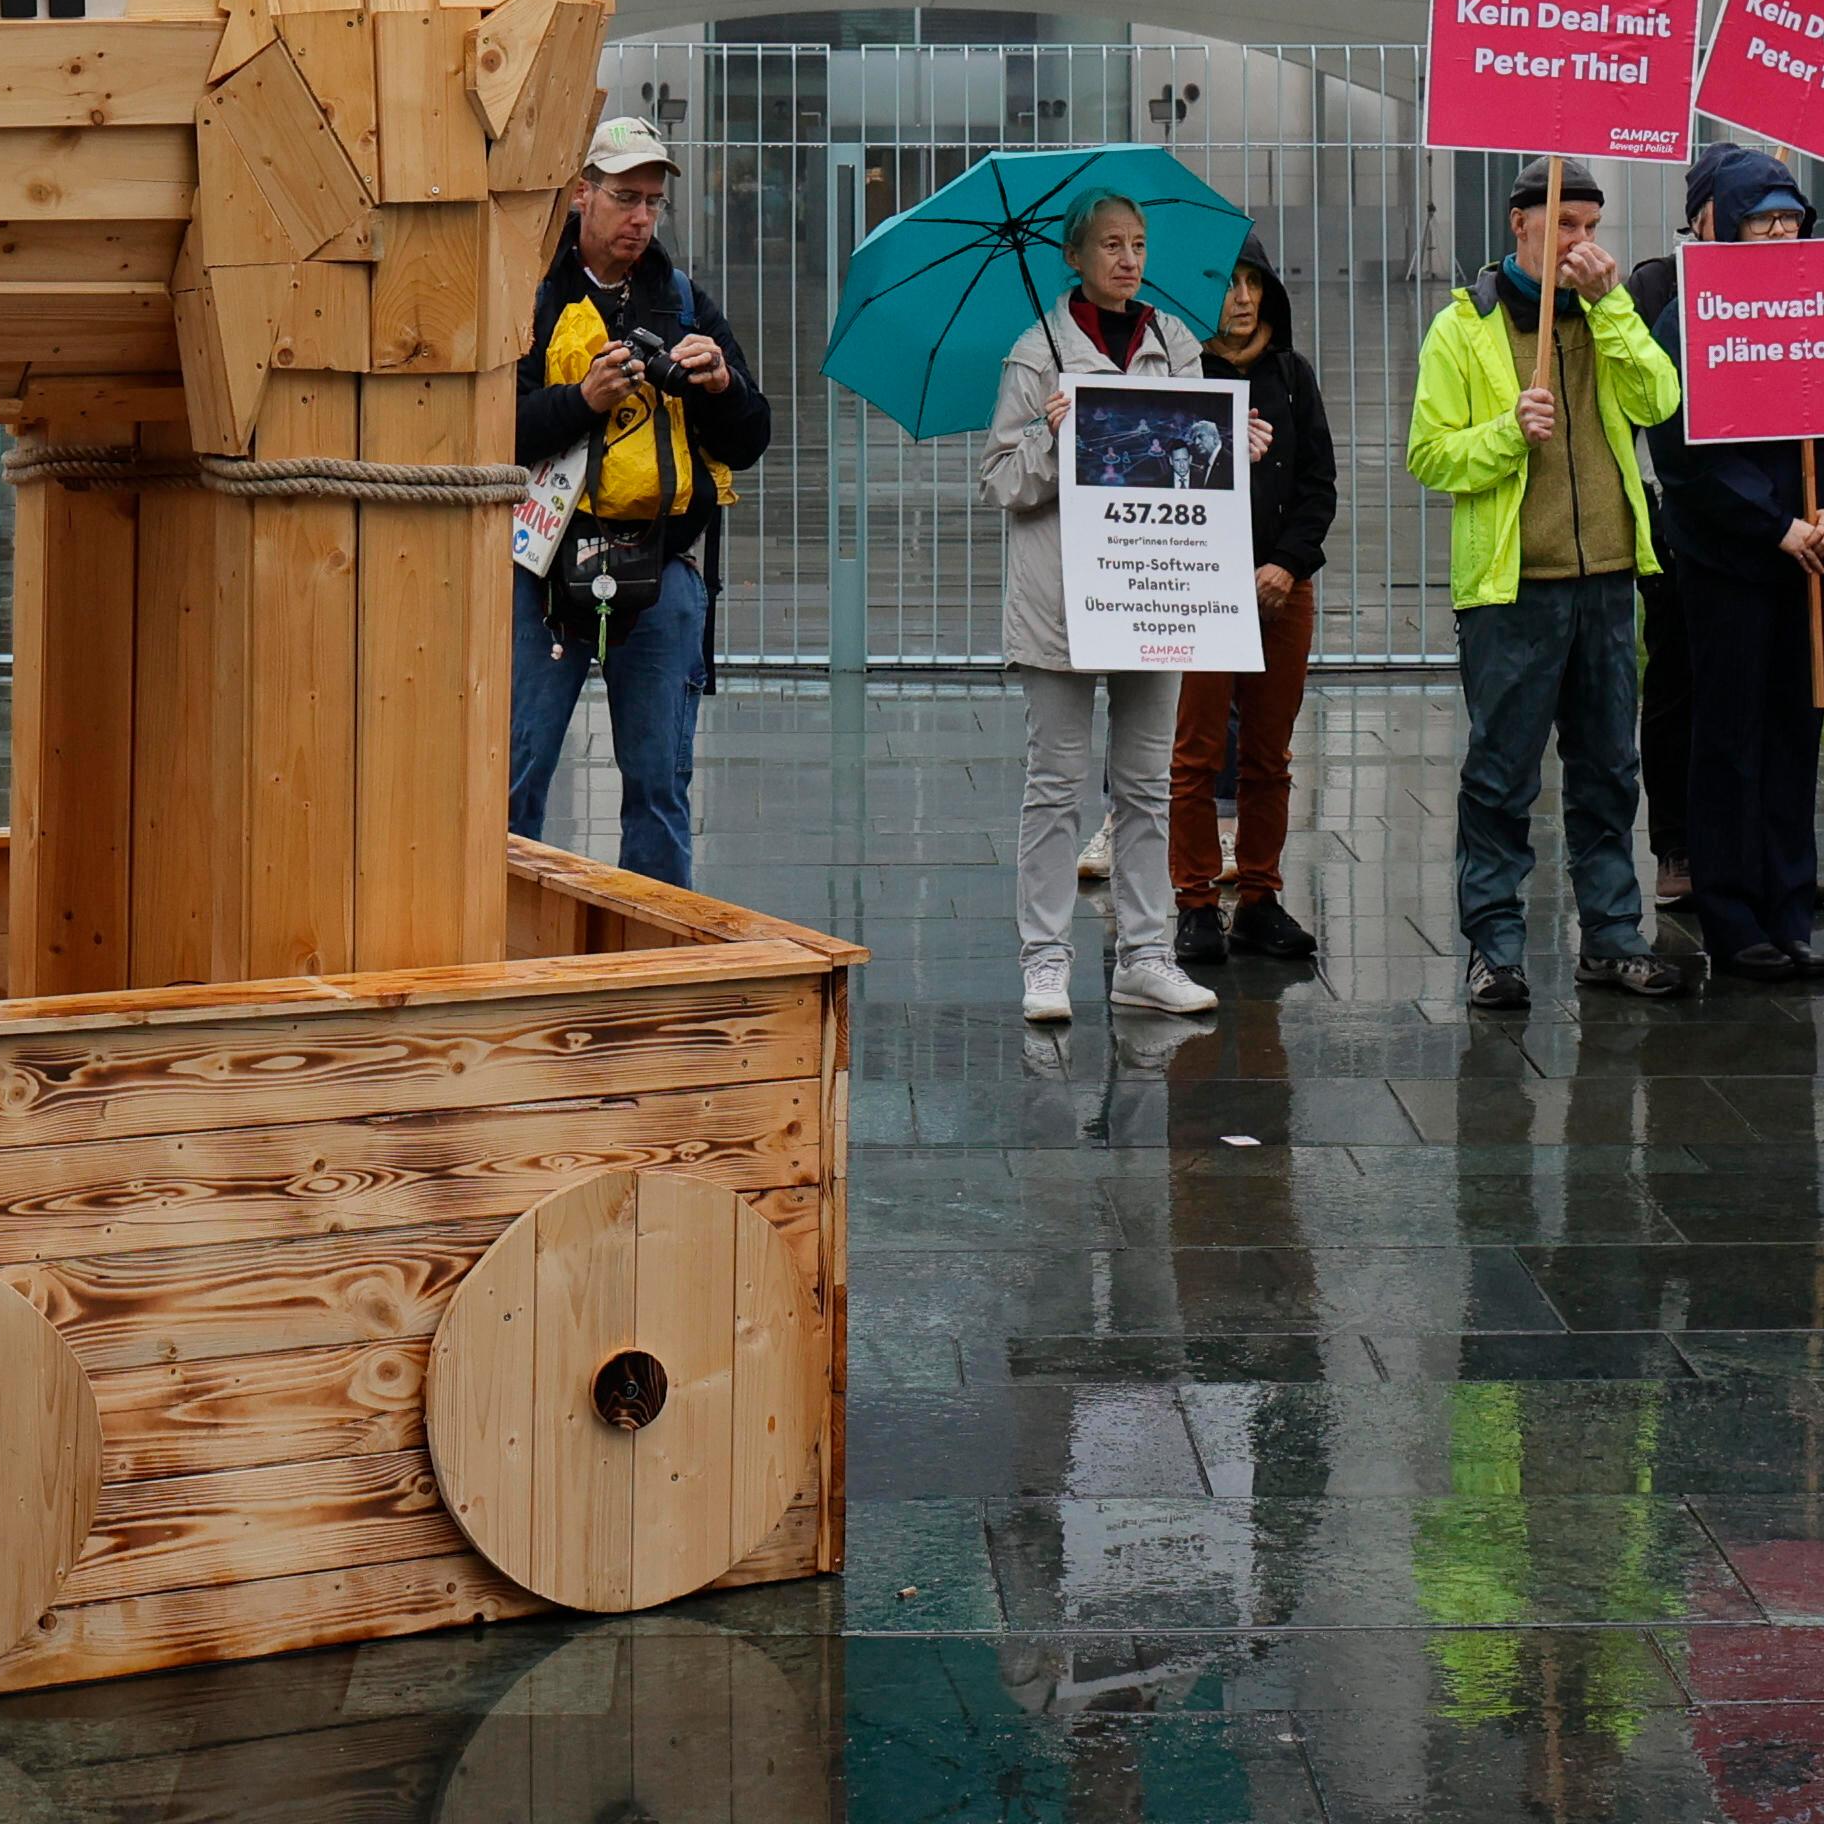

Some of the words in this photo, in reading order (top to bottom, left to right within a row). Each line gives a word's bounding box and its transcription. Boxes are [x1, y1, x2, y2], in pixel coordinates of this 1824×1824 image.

[1538, 3, 1609, 32] Deal
[1617, 9, 1670, 37] mit
[1476, 48, 1565, 77] Peter
[1571, 53, 1647, 84] Thiel
[1747, 38, 1817, 81] Peter
[1610, 128, 1679, 143] CAMPACT
[1610, 141, 1643, 153] Bewegt
[1645, 144, 1673, 153] Politik
[1709, 338, 1783, 368] pläne
[1104, 502, 1207, 526] 437.288
[1169, 537, 1208, 547] fordern:
[1097, 557, 1220, 573] Trump-Software
[1128, 577, 1190, 591] Palantir:
[1085, 596, 1239, 616] Überwachungspläne
[1133, 621, 1196, 635] stoppen
[1140, 645, 1195, 655] CAMPACT
